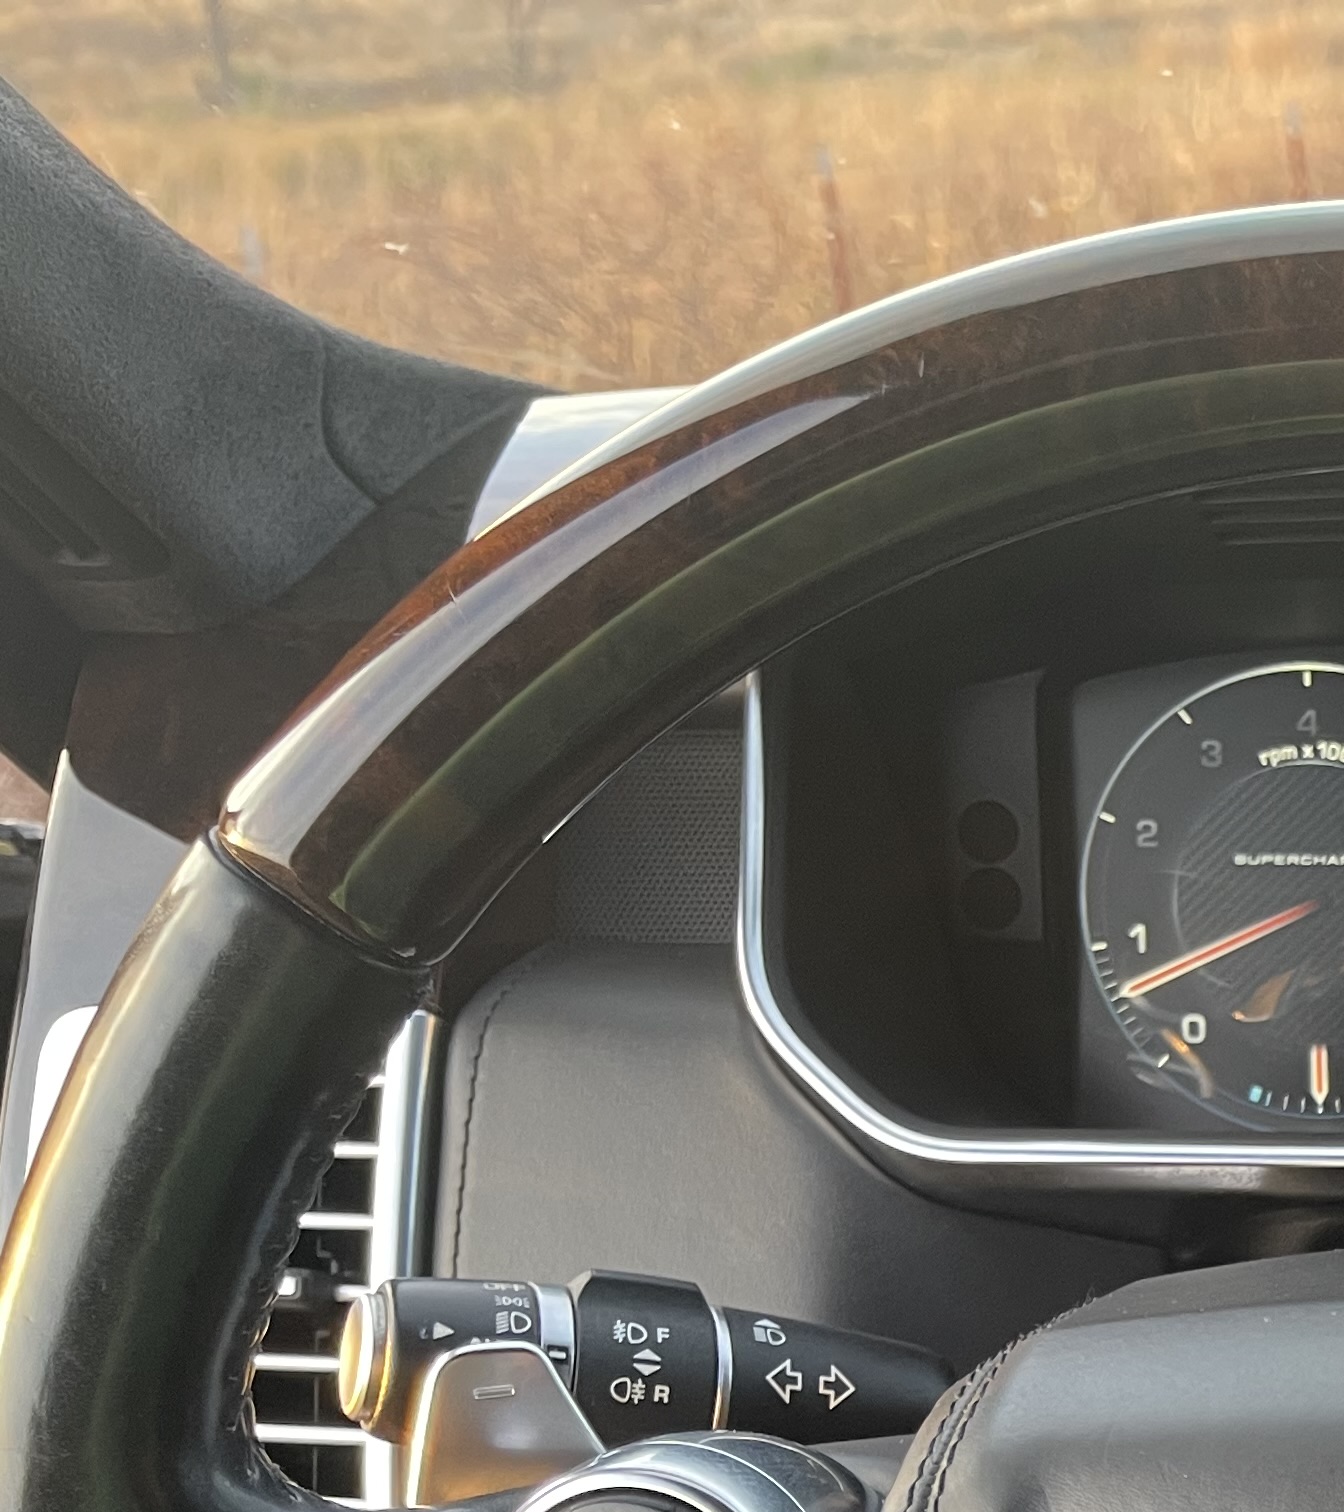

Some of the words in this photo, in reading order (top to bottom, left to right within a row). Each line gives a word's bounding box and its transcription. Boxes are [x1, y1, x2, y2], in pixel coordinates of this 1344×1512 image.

[1297, 710, 1317, 734] 4
[1201, 741, 1222, 767] 3
[1258, 743, 1298, 766] rpm
[1136, 820, 1158, 847] 2
[1129, 924, 1147, 954] 1
[1182, 1014, 1206, 1043] 0
[656, 1327, 670, 1343] F
[654, 1384, 670, 1404] R
